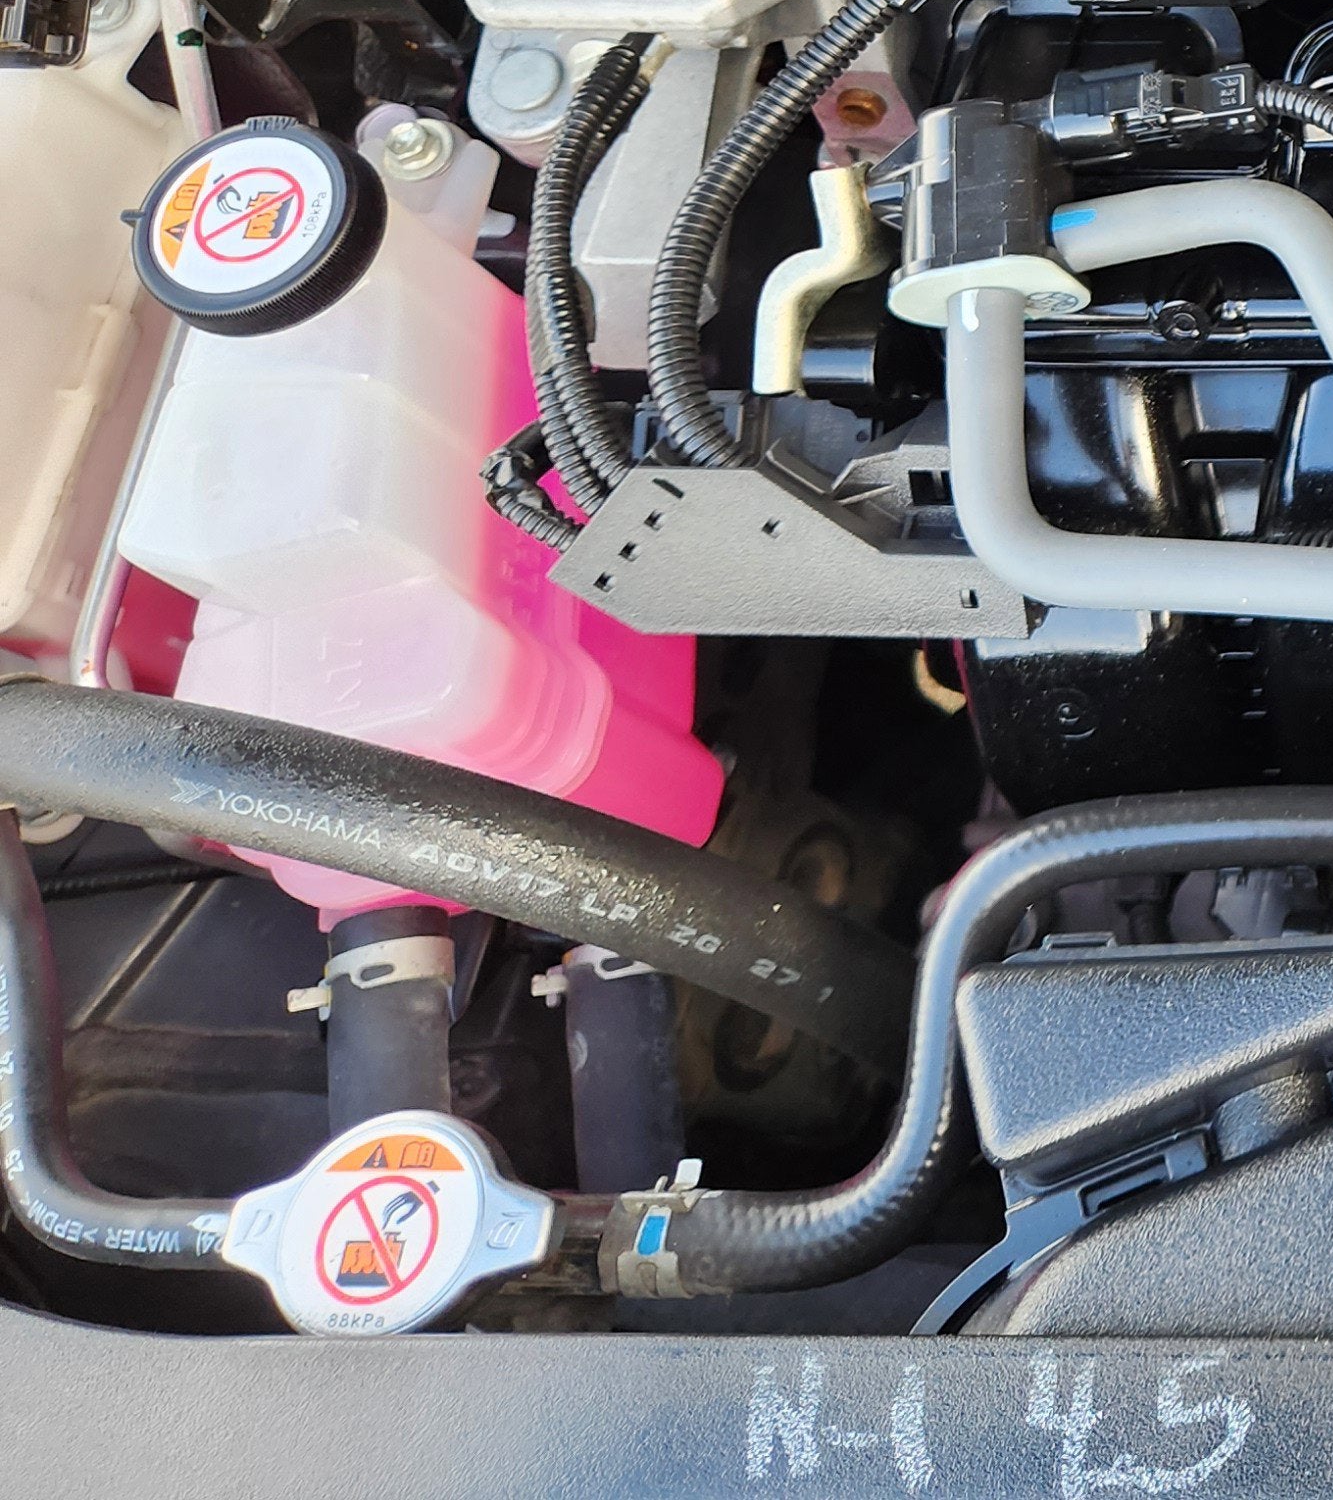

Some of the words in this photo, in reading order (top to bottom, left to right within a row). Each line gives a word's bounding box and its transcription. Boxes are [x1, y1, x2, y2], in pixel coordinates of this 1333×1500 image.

[302, 190, 328, 240] 108kPa
[216, 789, 383, 851] YOKOHAMA
[579, 892, 638, 924] LP
[750, 957, 802, 988] 27
[4, 1149, 25, 1180] 25
[104, 1226, 181, 1255] WATER
[326, 1312, 386, 1329] 88kPa
